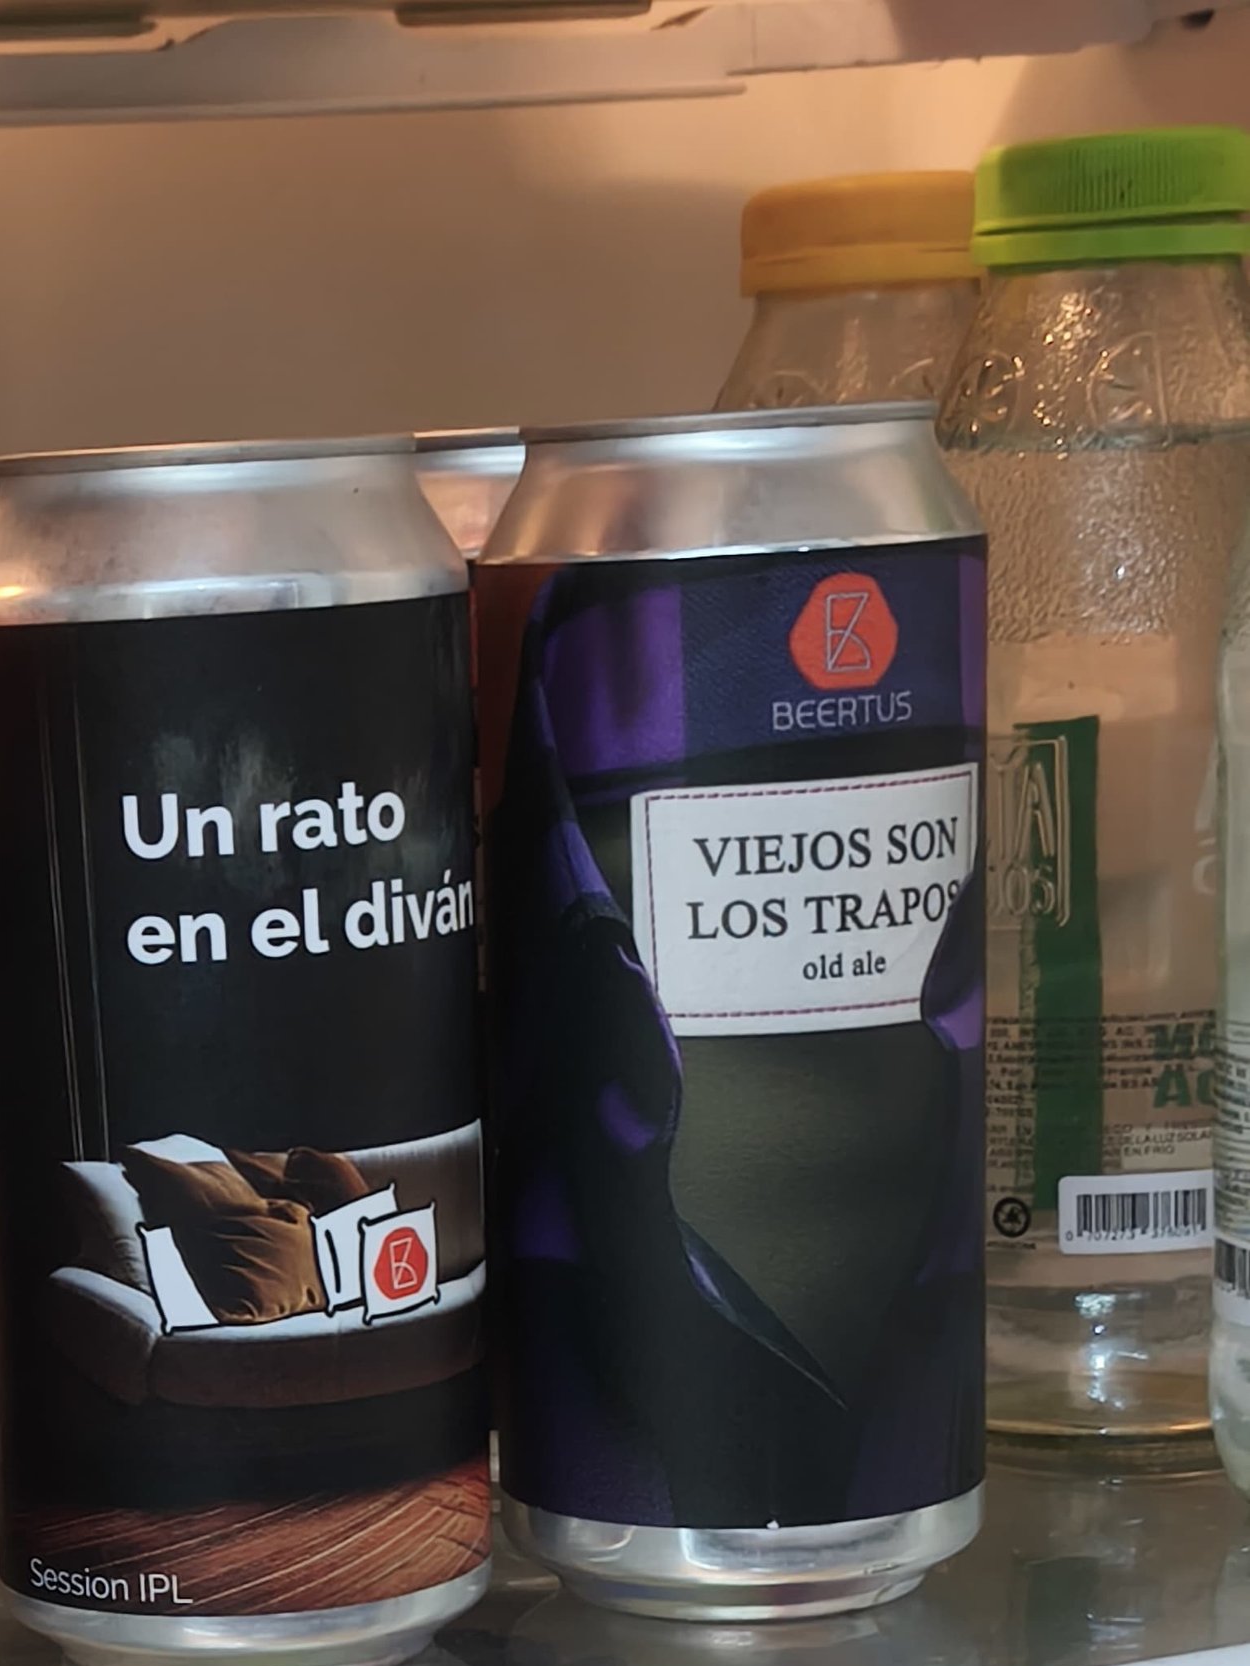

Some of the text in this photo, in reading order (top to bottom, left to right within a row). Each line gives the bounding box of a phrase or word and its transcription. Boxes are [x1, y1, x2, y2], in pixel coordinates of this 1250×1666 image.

[772, 690, 914, 732] BEERTUS
[121, 781, 406, 860] Un rato
[693, 816, 958, 877] VIEJOS SON
[126, 868, 474, 965] en el diván
[686, 899, 789, 941] LOS
[802, 951, 887, 981] old ale
[29, 1557, 195, 1605] Session IPL
